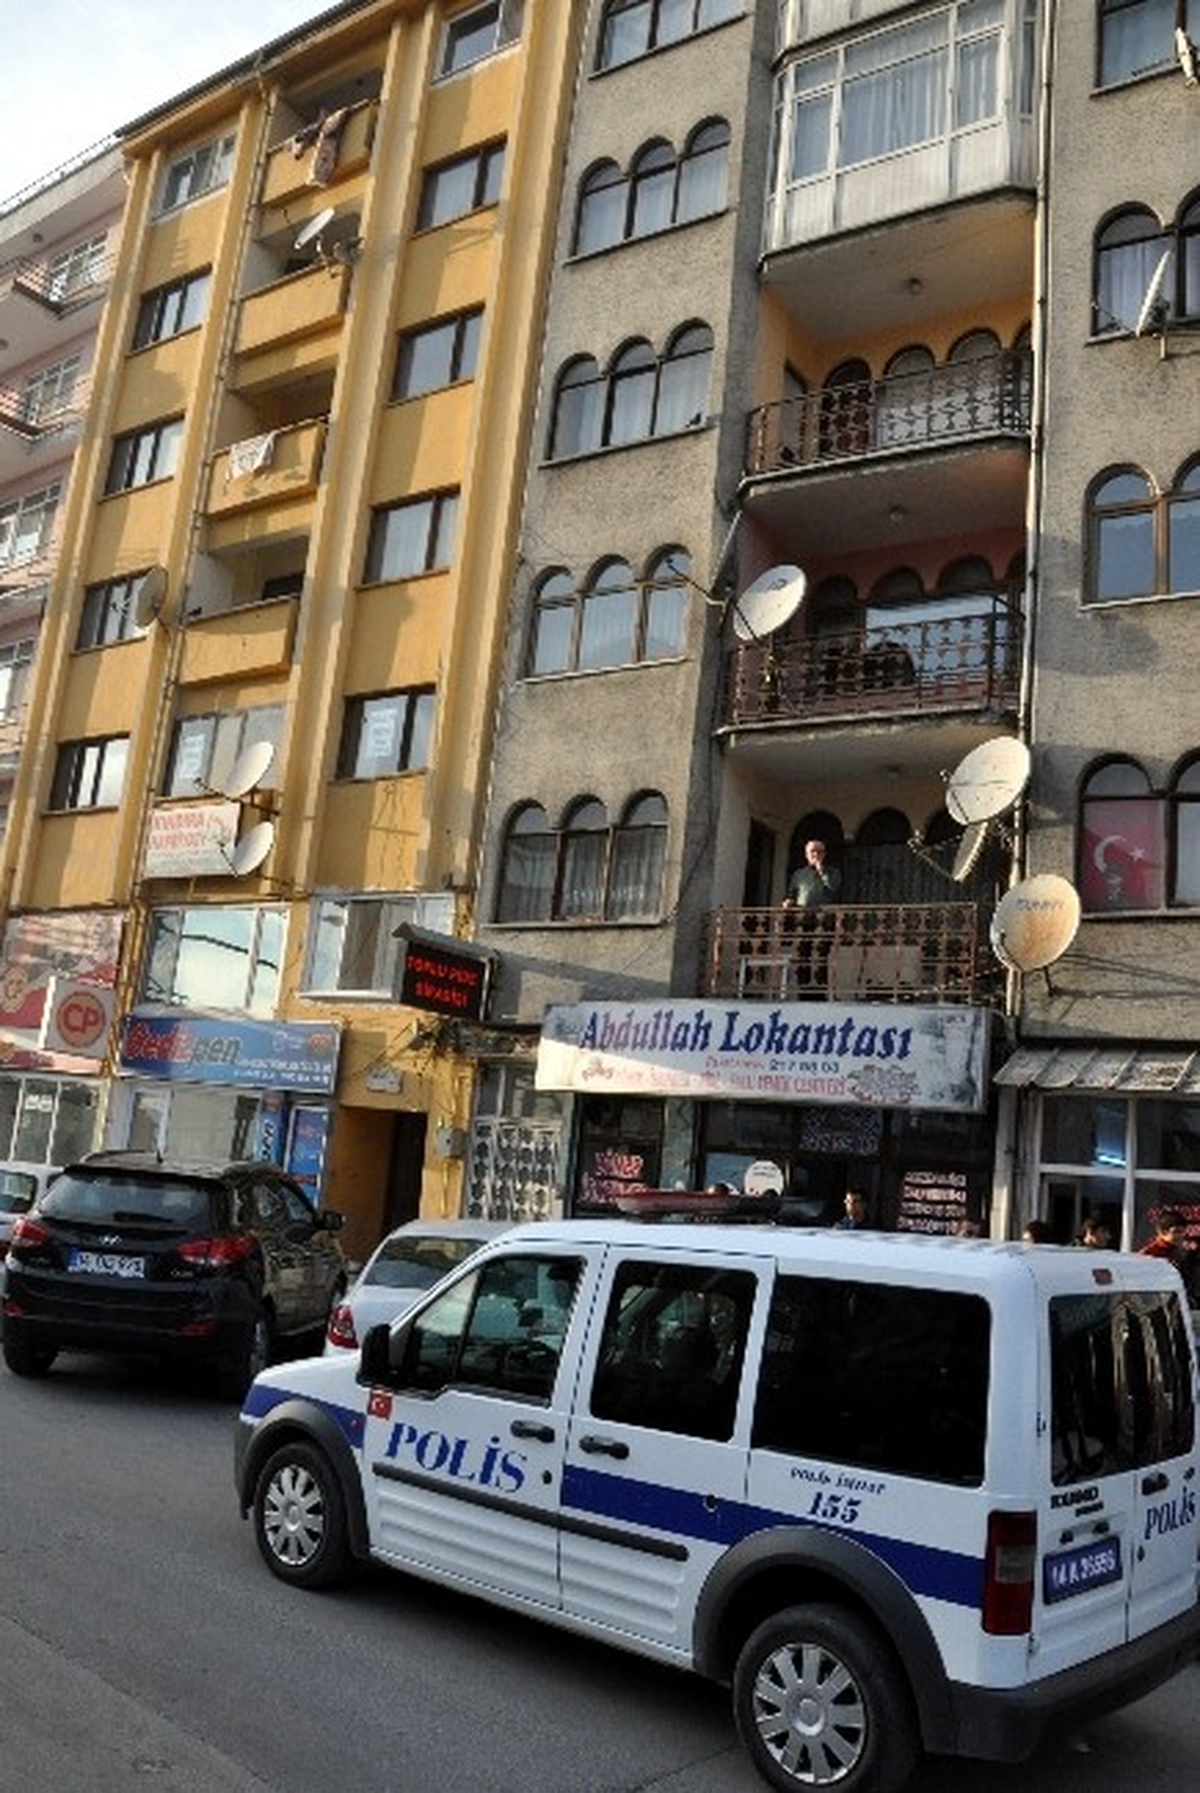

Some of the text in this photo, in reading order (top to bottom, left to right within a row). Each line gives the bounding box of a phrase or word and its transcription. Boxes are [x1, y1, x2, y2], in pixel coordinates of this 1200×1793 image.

[63, 1003, 100, 1035] CP
[579, 1009, 912, 1060] Abdullah Lokantası
[385, 1422, 528, 1494] POLİS
[808, 1491, 861, 1523] 155
[1145, 1486, 1197, 1540] POLİS
